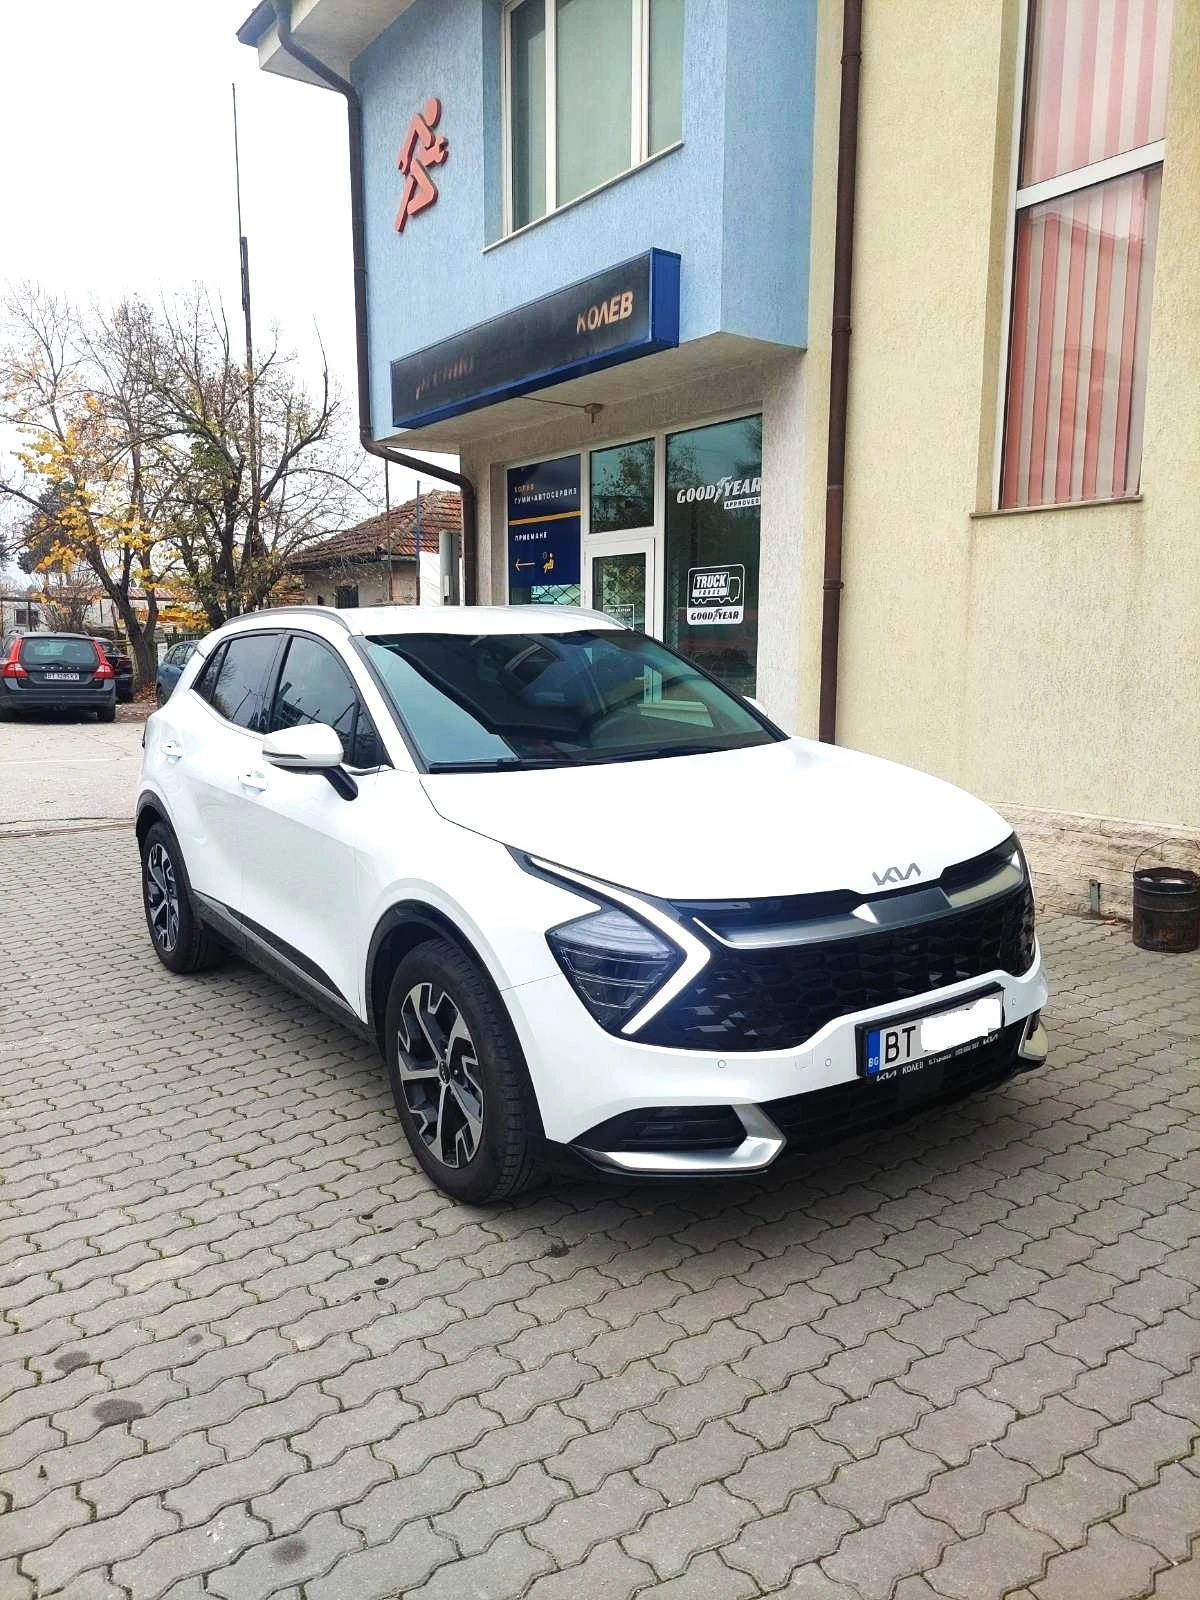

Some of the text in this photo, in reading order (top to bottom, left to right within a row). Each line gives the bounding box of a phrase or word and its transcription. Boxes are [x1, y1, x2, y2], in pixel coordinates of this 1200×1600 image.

[576, 290, 634, 334] КОЛЕВ
[676, 476, 761, 504] GOODYEAR
[725, 498, 760, 508] APPROVED
[514, 531, 547, 542] ПРИЕМАНЕ
[696, 574, 726, 589] TRUCK
[690, 608, 739, 622] GOODYEAR
[872, 862, 921, 886] KIA
[868, 1055, 879, 1068] BG
